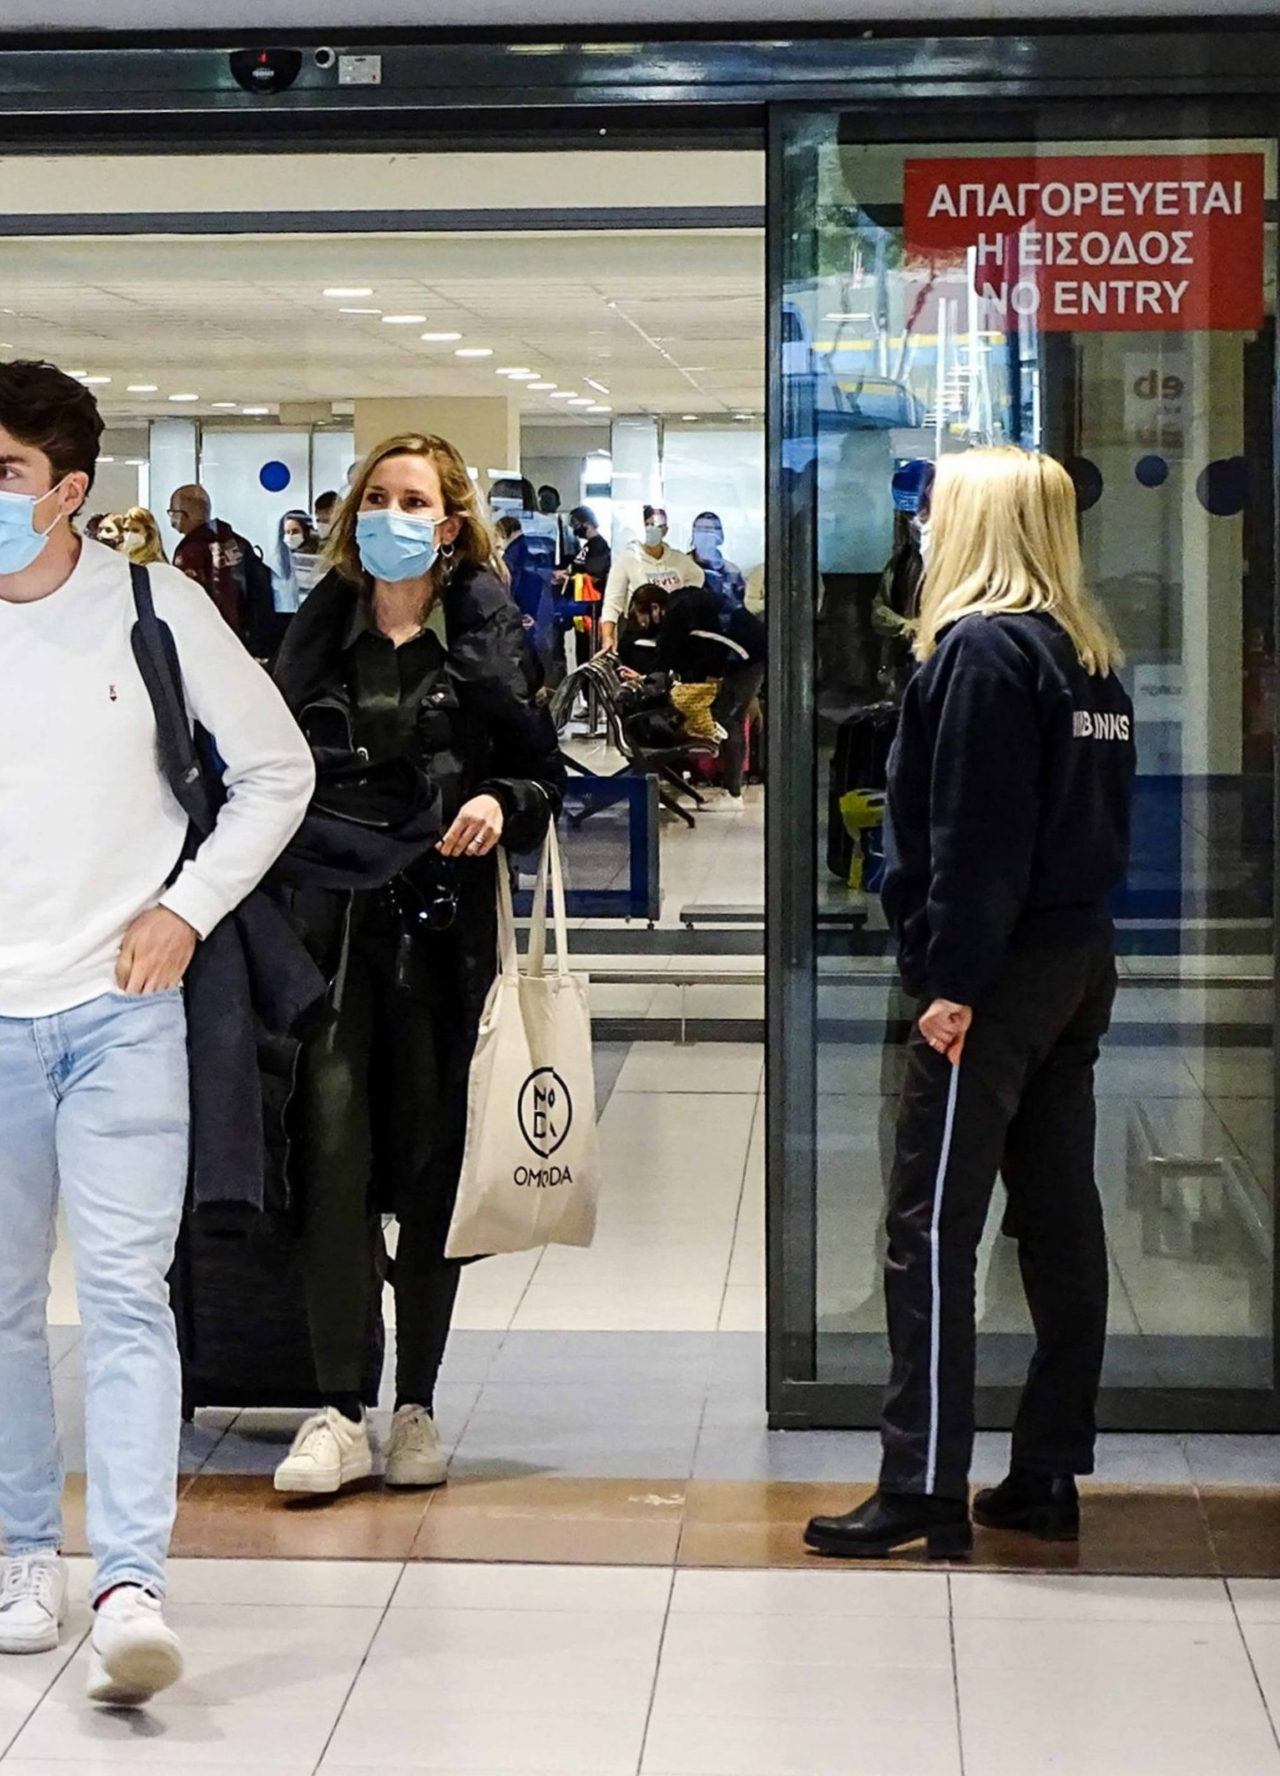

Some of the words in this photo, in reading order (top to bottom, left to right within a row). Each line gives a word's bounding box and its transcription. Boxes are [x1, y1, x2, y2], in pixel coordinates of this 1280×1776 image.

[927, 181, 1243, 217] ΑΠΑΓΟΡΕΥΕΤΑΙ
[977, 232, 1004, 266] Η
[1020, 231, 1194, 266] ΕΙΣΟΔΟΣ
[981, 282, 1040, 315] NO
[1054, 280, 1190, 315] ENTRY
[513, 1165, 573, 1188] OMODA
